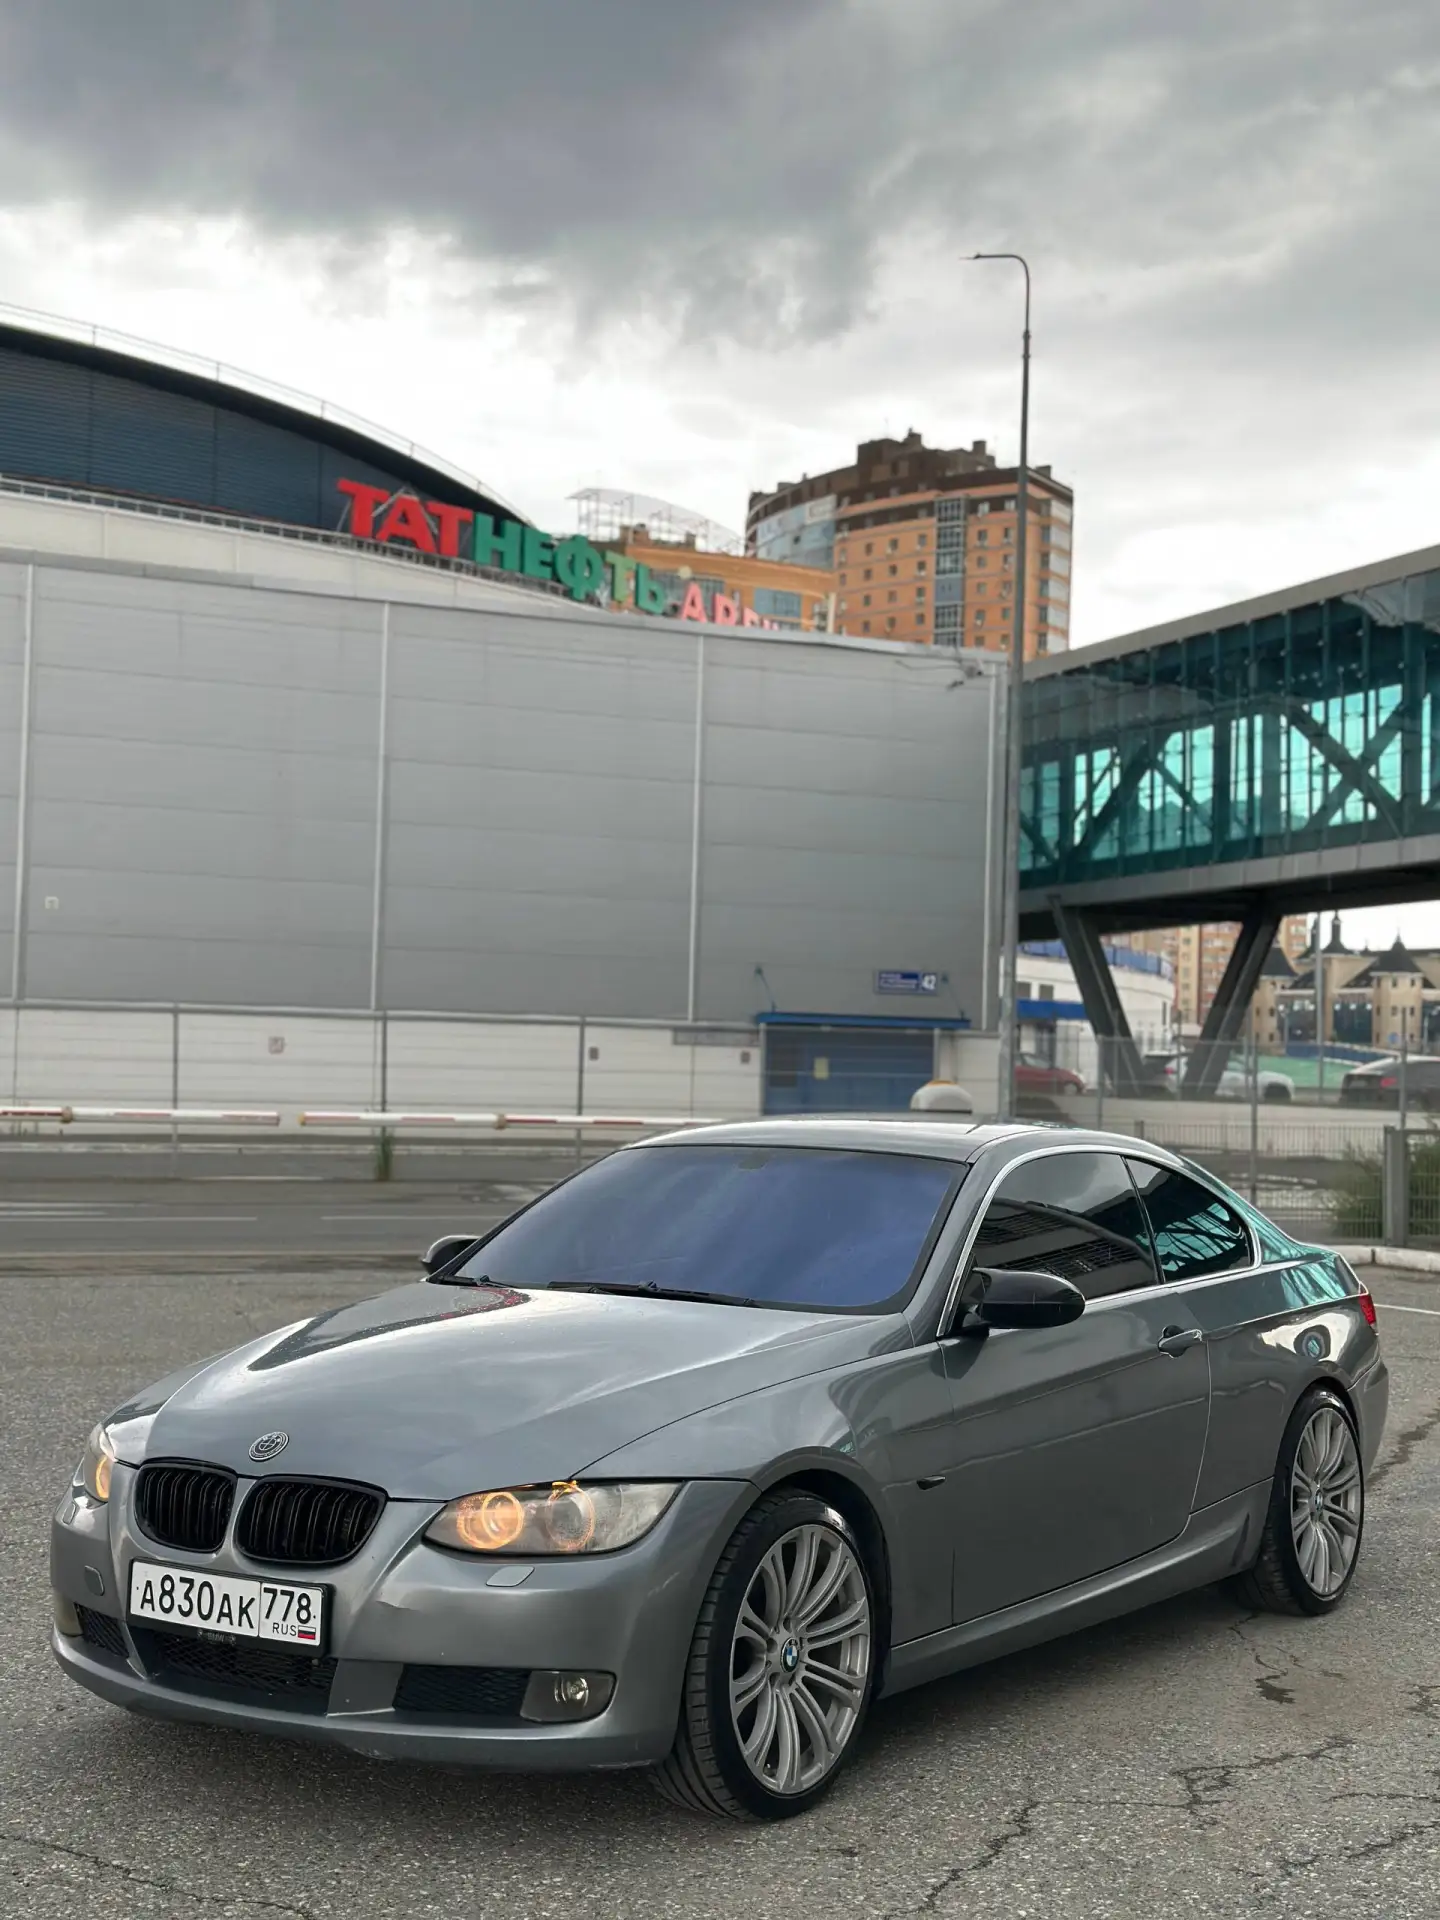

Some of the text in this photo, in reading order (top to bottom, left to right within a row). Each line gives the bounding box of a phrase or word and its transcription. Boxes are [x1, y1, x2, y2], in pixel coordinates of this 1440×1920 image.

[338, 479, 664, 613] ТАТНЕФТЬ
[922, 974, 936, 990] 42
[140, 1574, 312, 1629] А830АК 778
[272, 1622, 297, 1637] RUS
